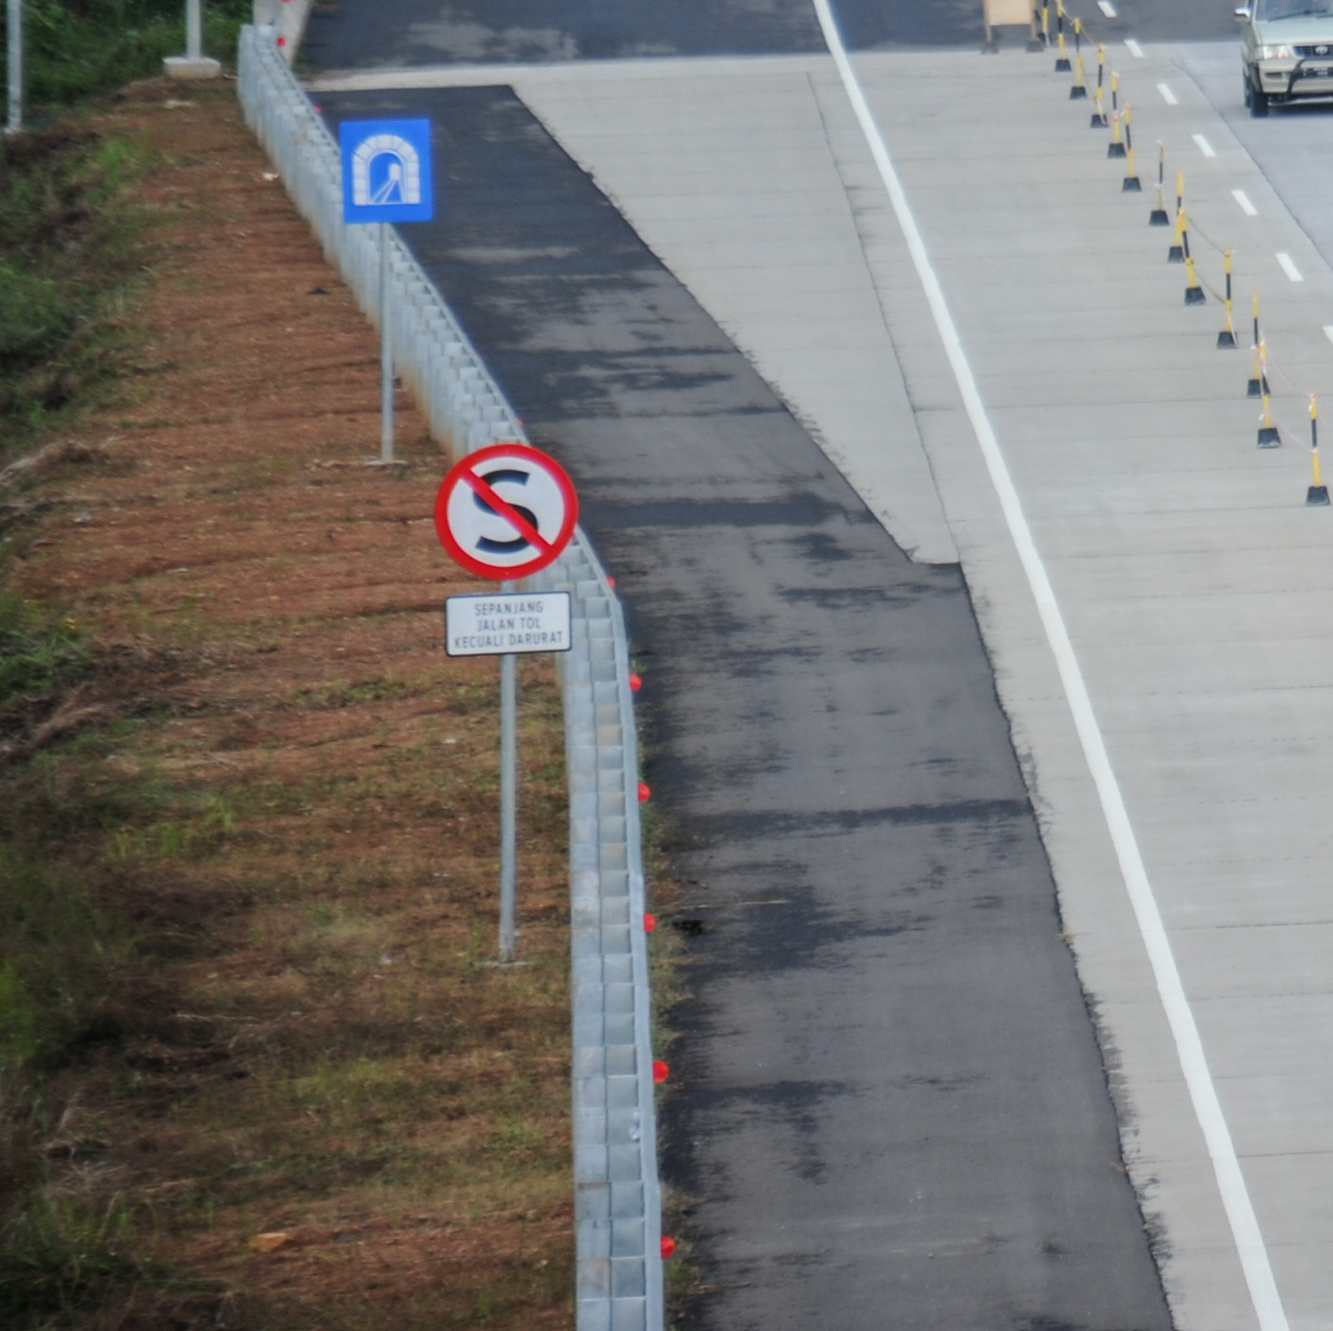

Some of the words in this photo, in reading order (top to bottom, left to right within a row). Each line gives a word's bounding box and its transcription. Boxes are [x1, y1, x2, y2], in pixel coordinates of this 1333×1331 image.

[474, 601, 544, 616] SEPANJANG
[477, 618, 515, 632] JALAN
[519, 617, 541, 630] TOL
[454, 635, 504, 649] KECUALI
[508, 631, 563, 646] DARURAT
